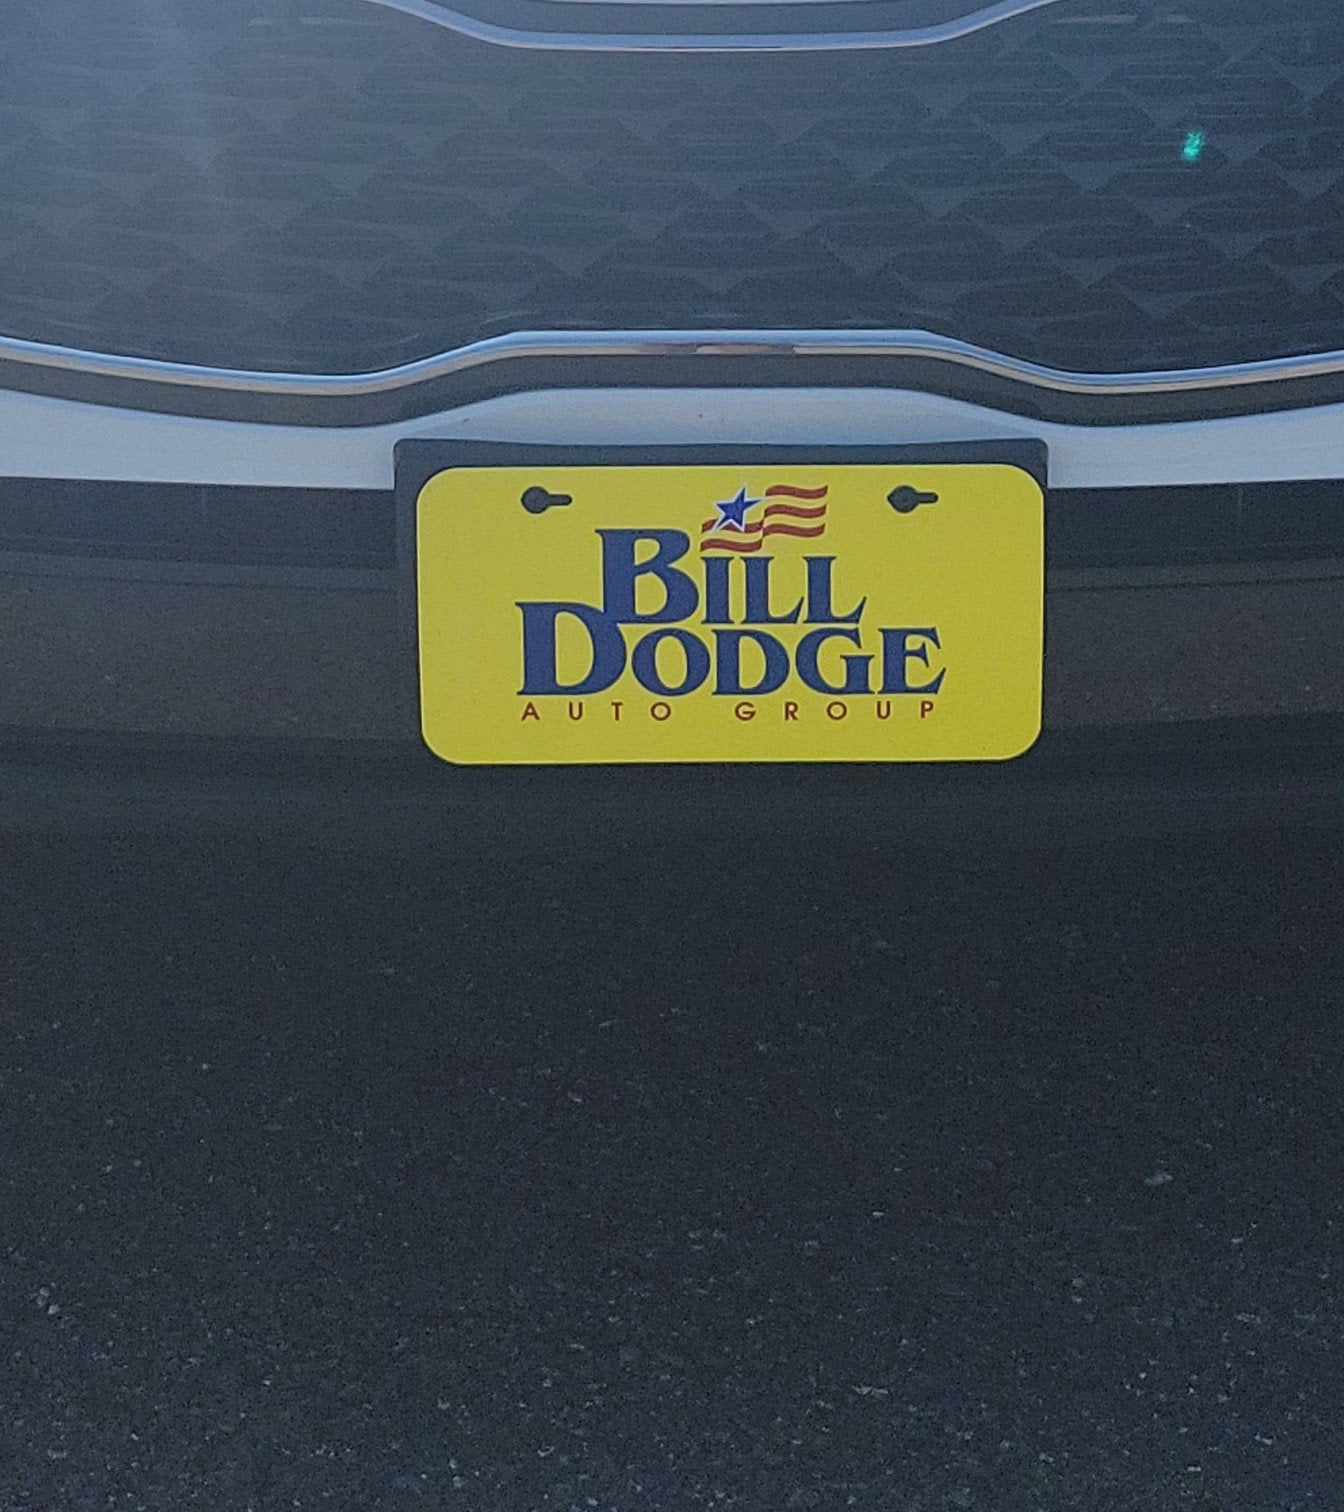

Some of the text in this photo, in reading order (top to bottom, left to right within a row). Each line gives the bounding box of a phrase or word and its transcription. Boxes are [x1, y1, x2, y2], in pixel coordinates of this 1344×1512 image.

[594, 528, 867, 624] BILL
[514, 600, 947, 697] DODGE
[520, 699, 937, 723] AUTO GROUP
